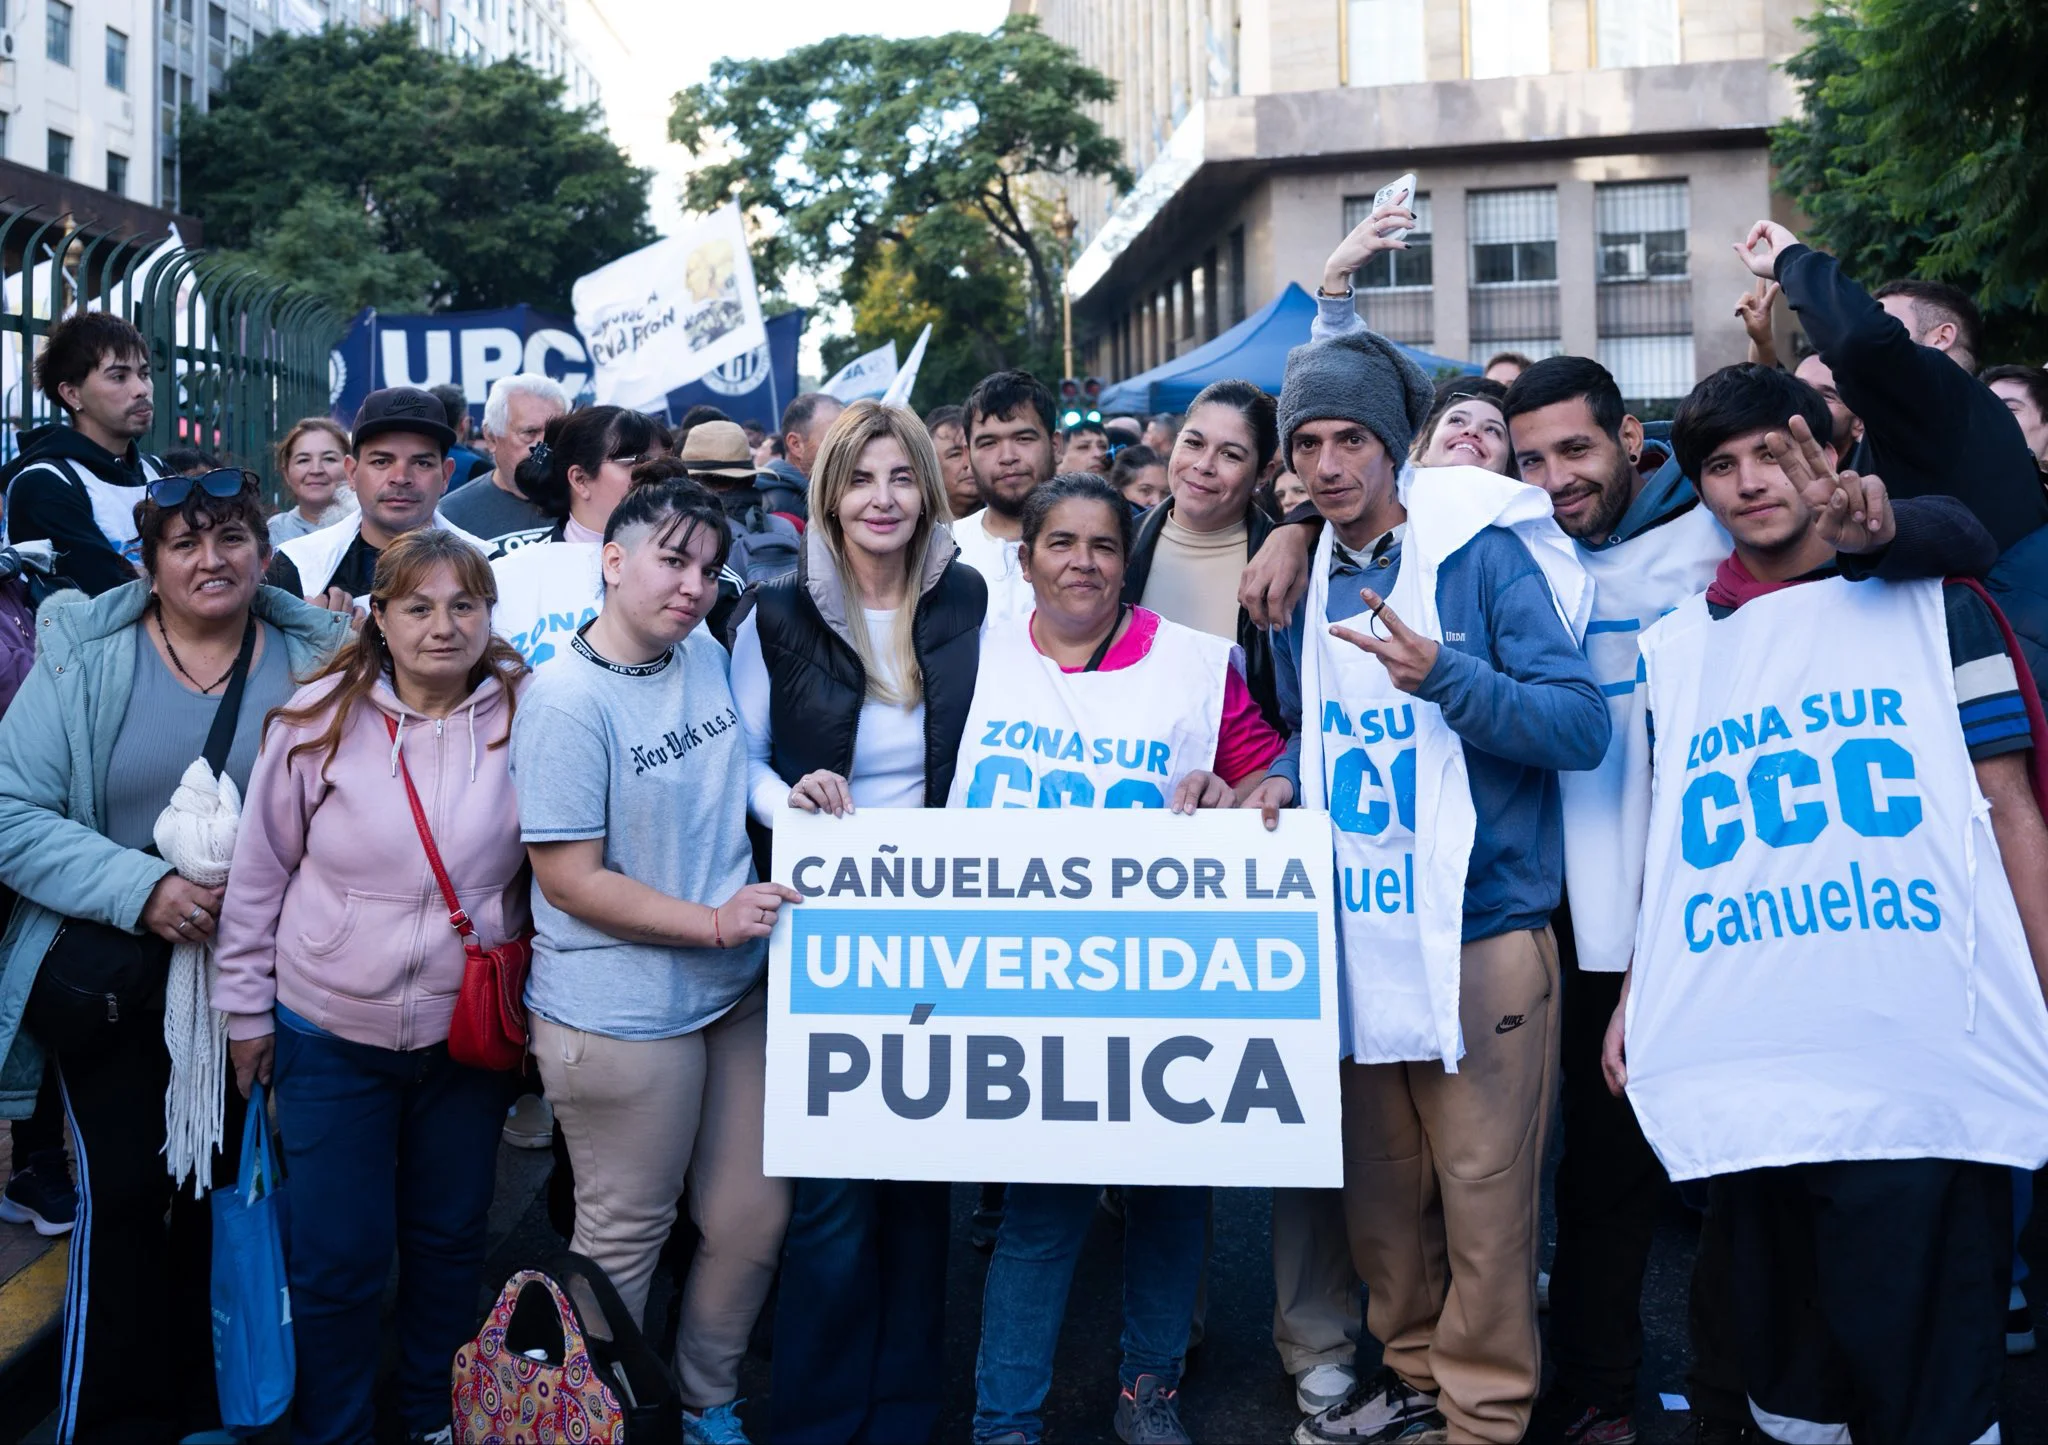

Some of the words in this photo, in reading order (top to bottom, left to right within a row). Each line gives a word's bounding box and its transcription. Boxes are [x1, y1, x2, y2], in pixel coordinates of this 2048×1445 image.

[511, 607, 599, 654] ZONA
[571, 638, 594, 660] YORK
[609, 664, 640, 675] NEW
[643, 661, 667, 675] YORK
[980, 720, 1084, 762] ZONA
[1093, 737, 1171, 777] SUR
[1360, 703, 1415, 745] SU
[1686, 705, 1793, 772] ZONA
[1801, 688, 1907, 733] SUR
[630, 744, 668, 776] New
[1681, 738, 1922, 871] CCC
[791, 845, 1093, 899] CAÑUELAS
[1112, 857, 1226, 900] POR
[1245, 857, 1316, 900] LA
[806, 935, 1306, 992] UNIVERSIDAD
[1501, 1014, 1524, 1026] NIKE
[807, 1003, 1306, 1124] PÚBLICA
